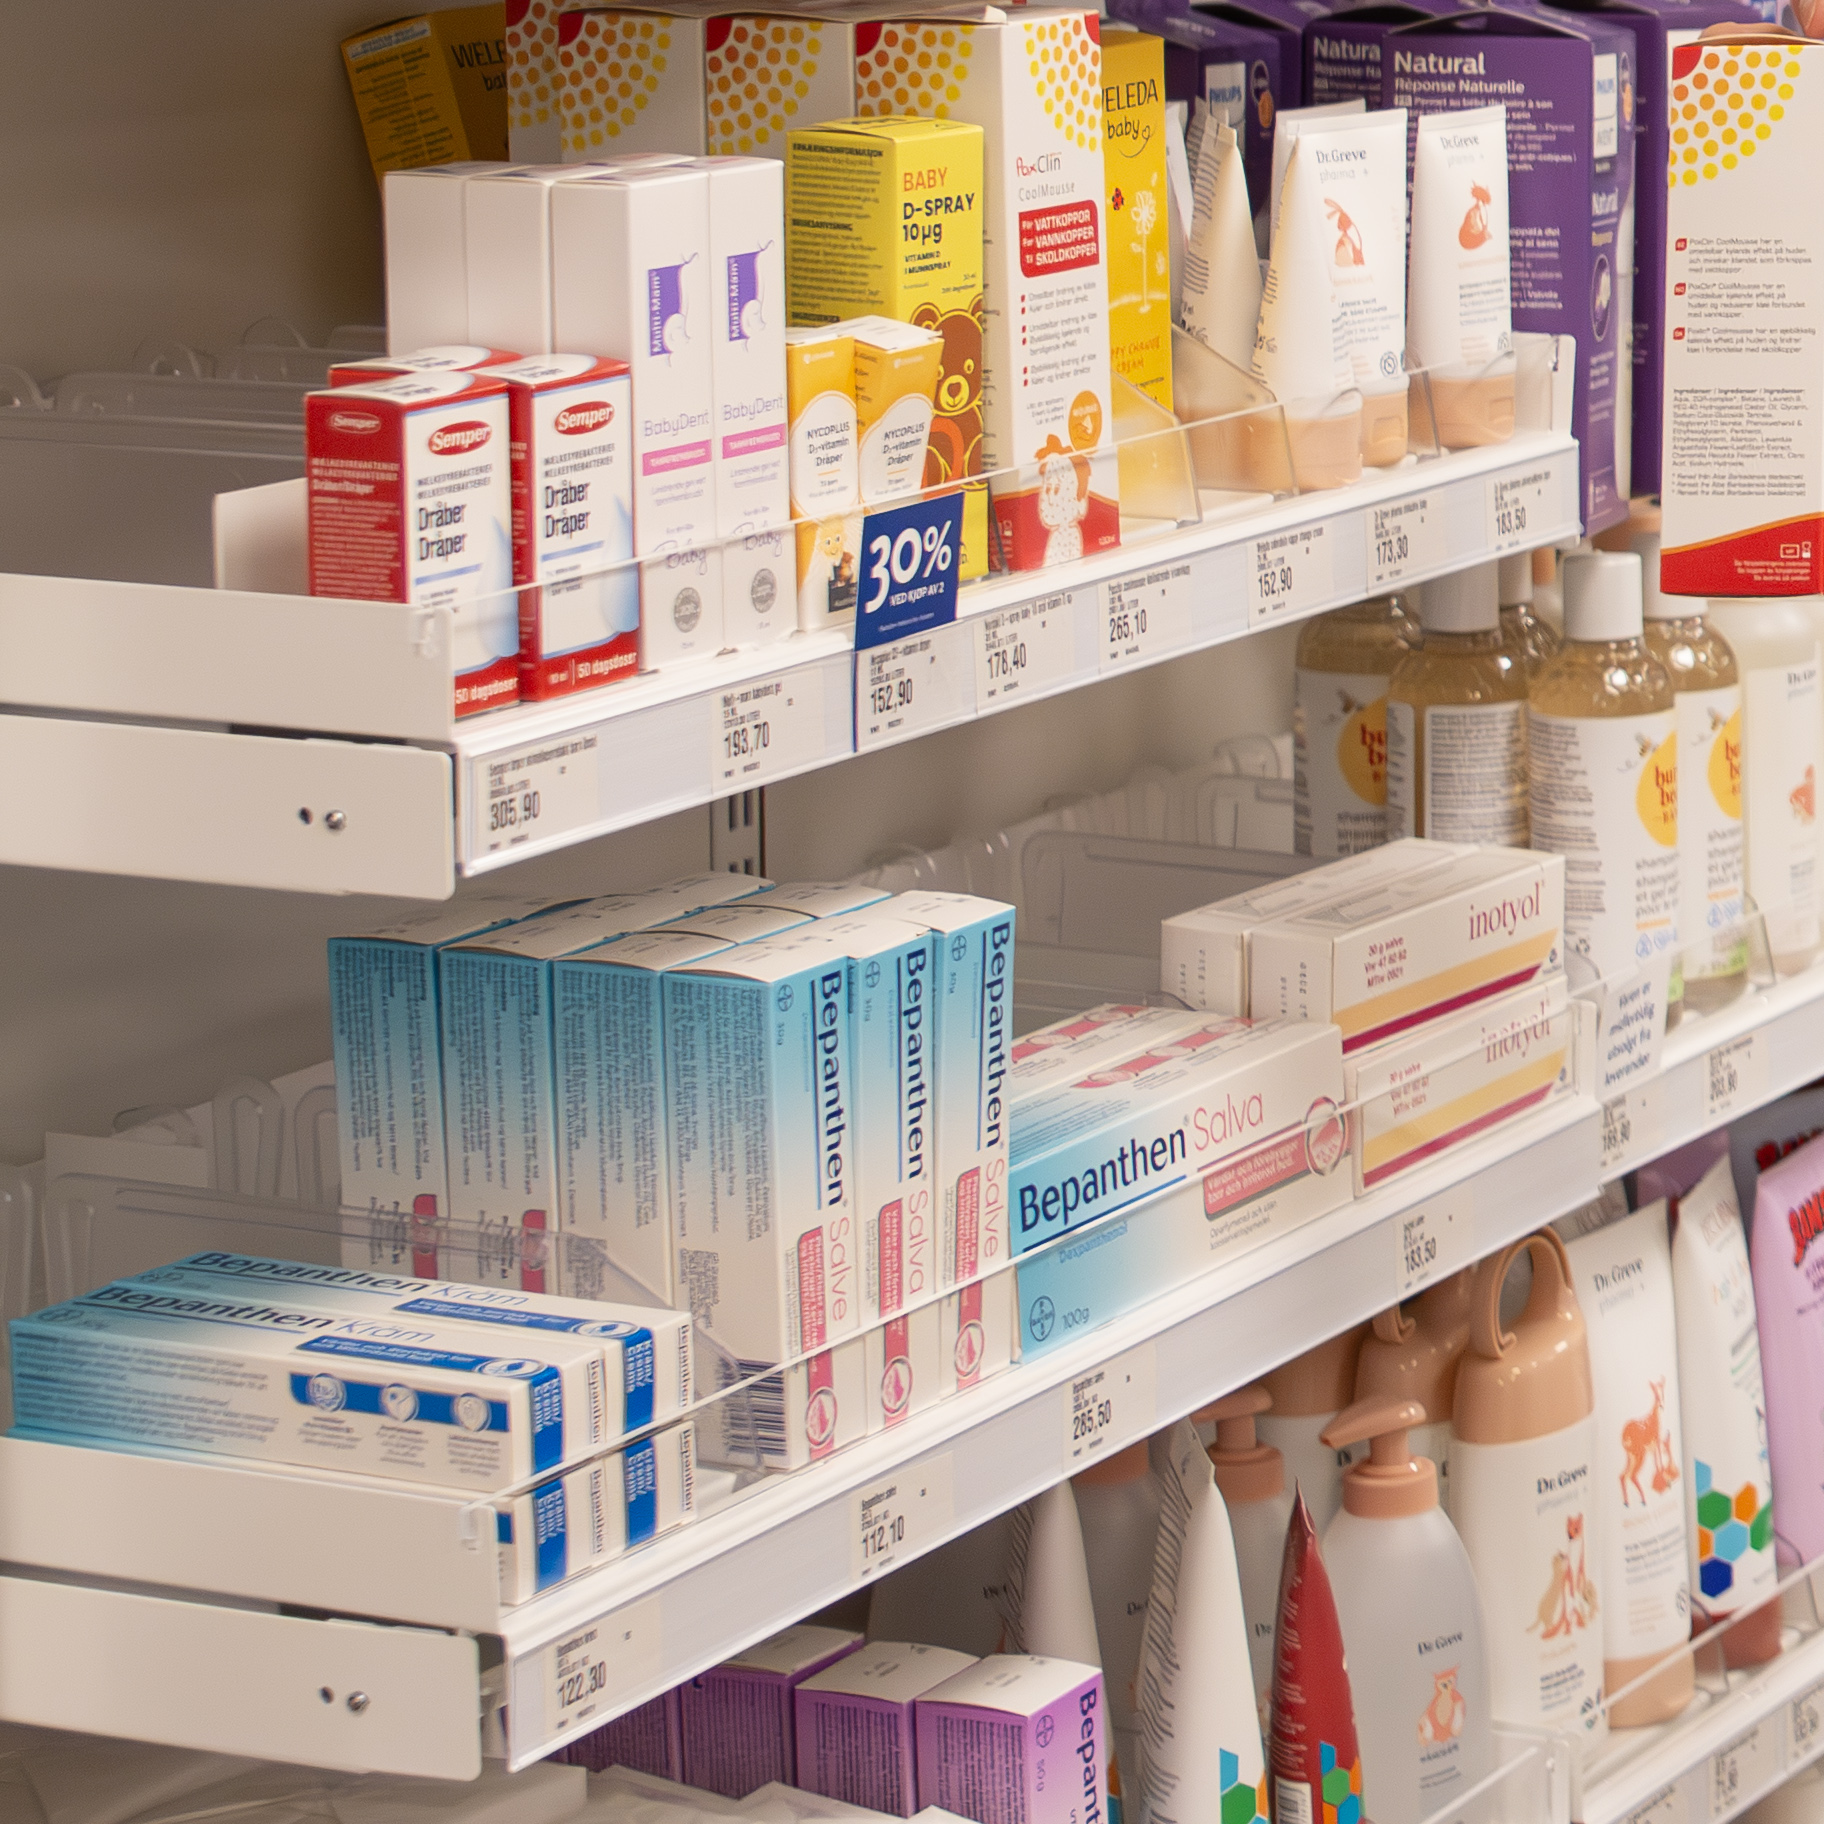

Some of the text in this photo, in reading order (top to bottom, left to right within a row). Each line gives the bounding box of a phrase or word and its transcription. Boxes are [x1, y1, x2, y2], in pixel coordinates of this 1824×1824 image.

[1313, 37, 1381, 61] Natura
[1394, 50, 1486, 75] Natural
[1101, 78, 1159, 113] ELEDA
[1395, 78, 1526, 95] Réponse Naturelle
[1106, 117, 1140, 141] baby
[902, 167, 949, 192] BABY
[1015, 152, 1062, 177] PoxClin
[902, 193, 976, 221] D-SPRAY
[1018, 181, 1076, 203] CoolMousse
[1033, 209, 1091, 232] VATTKOPPOR
[1034, 226, 1095, 249] VANNKOPPER
[1035, 242, 1098, 266] SKOLDKOPPER
[649, 270, 664, 354] Multi-Mam
[728, 257, 741, 339] Multi-Mam
[332, 414, 381, 429] Semper
[556, 403, 615, 433] Semper
[644, 408, 710, 437] BabyDent
[723, 394, 785, 423] BabyDent
[430, 424, 493, 452] Semper
[806, 421, 851, 441] NYCOPLUS
[882, 421, 926, 441] NYCOPLUS
[816, 452, 843, 467] Dråper
[886, 451, 914, 467] Dråper
[545, 479, 592, 510] Dråber
[417, 501, 468, 532] Dråber
[545, 509, 592, 540] Dråper
[1495, 507, 1528, 537] 183,50
[418, 531, 468, 563] Dråper
[1375, 534, 1409, 567] 173,30
[864, 519, 953, 614] 30%
[1257, 565, 1294, 599] 152,90
[889, 581, 945, 607] VED KJØP AV 2
[1109, 609, 1148, 643] 265,10
[577, 651, 637, 678] 50 dagsdoser
[987, 642, 1028, 680] 178,40
[469, 675, 519, 702] dagsdoser
[869, 678, 914, 717] 152,90
[723, 721, 771, 759] 193,70
[489, 790, 540, 832] 305,90
[1468, 881, 1540, 941] inotyol
[985, 920, 1011, 1150] Bepanthen
[903, 947, 929, 1180] Bepanthen
[817, 969, 846, 1208] Bepanthen
[1193, 1092, 1264, 1152] Salva
[1019, 1127, 1187, 1234] Bepanthen
[984, 1156, 1005, 1259] Salve
[907, 1188, 929, 1296] Salva
[1404, 1237, 1438, 1276] 183,50
[196, 1250, 431, 1295] Bepanthen
[828, 1215, 850, 1323] Salve
[86, 1284, 337, 1333] Bepanthen
[339, 1318, 439, 1345] Kräm
[679, 1324, 690, 1408] Bepanthen
[1072, 1399, 1113, 1441] 285,50
[861, 1515, 905, 1559] 112,10
[555, 1661, 607, 1710] 122,30
[1076, 1686, 1102, 1824] Bepant
